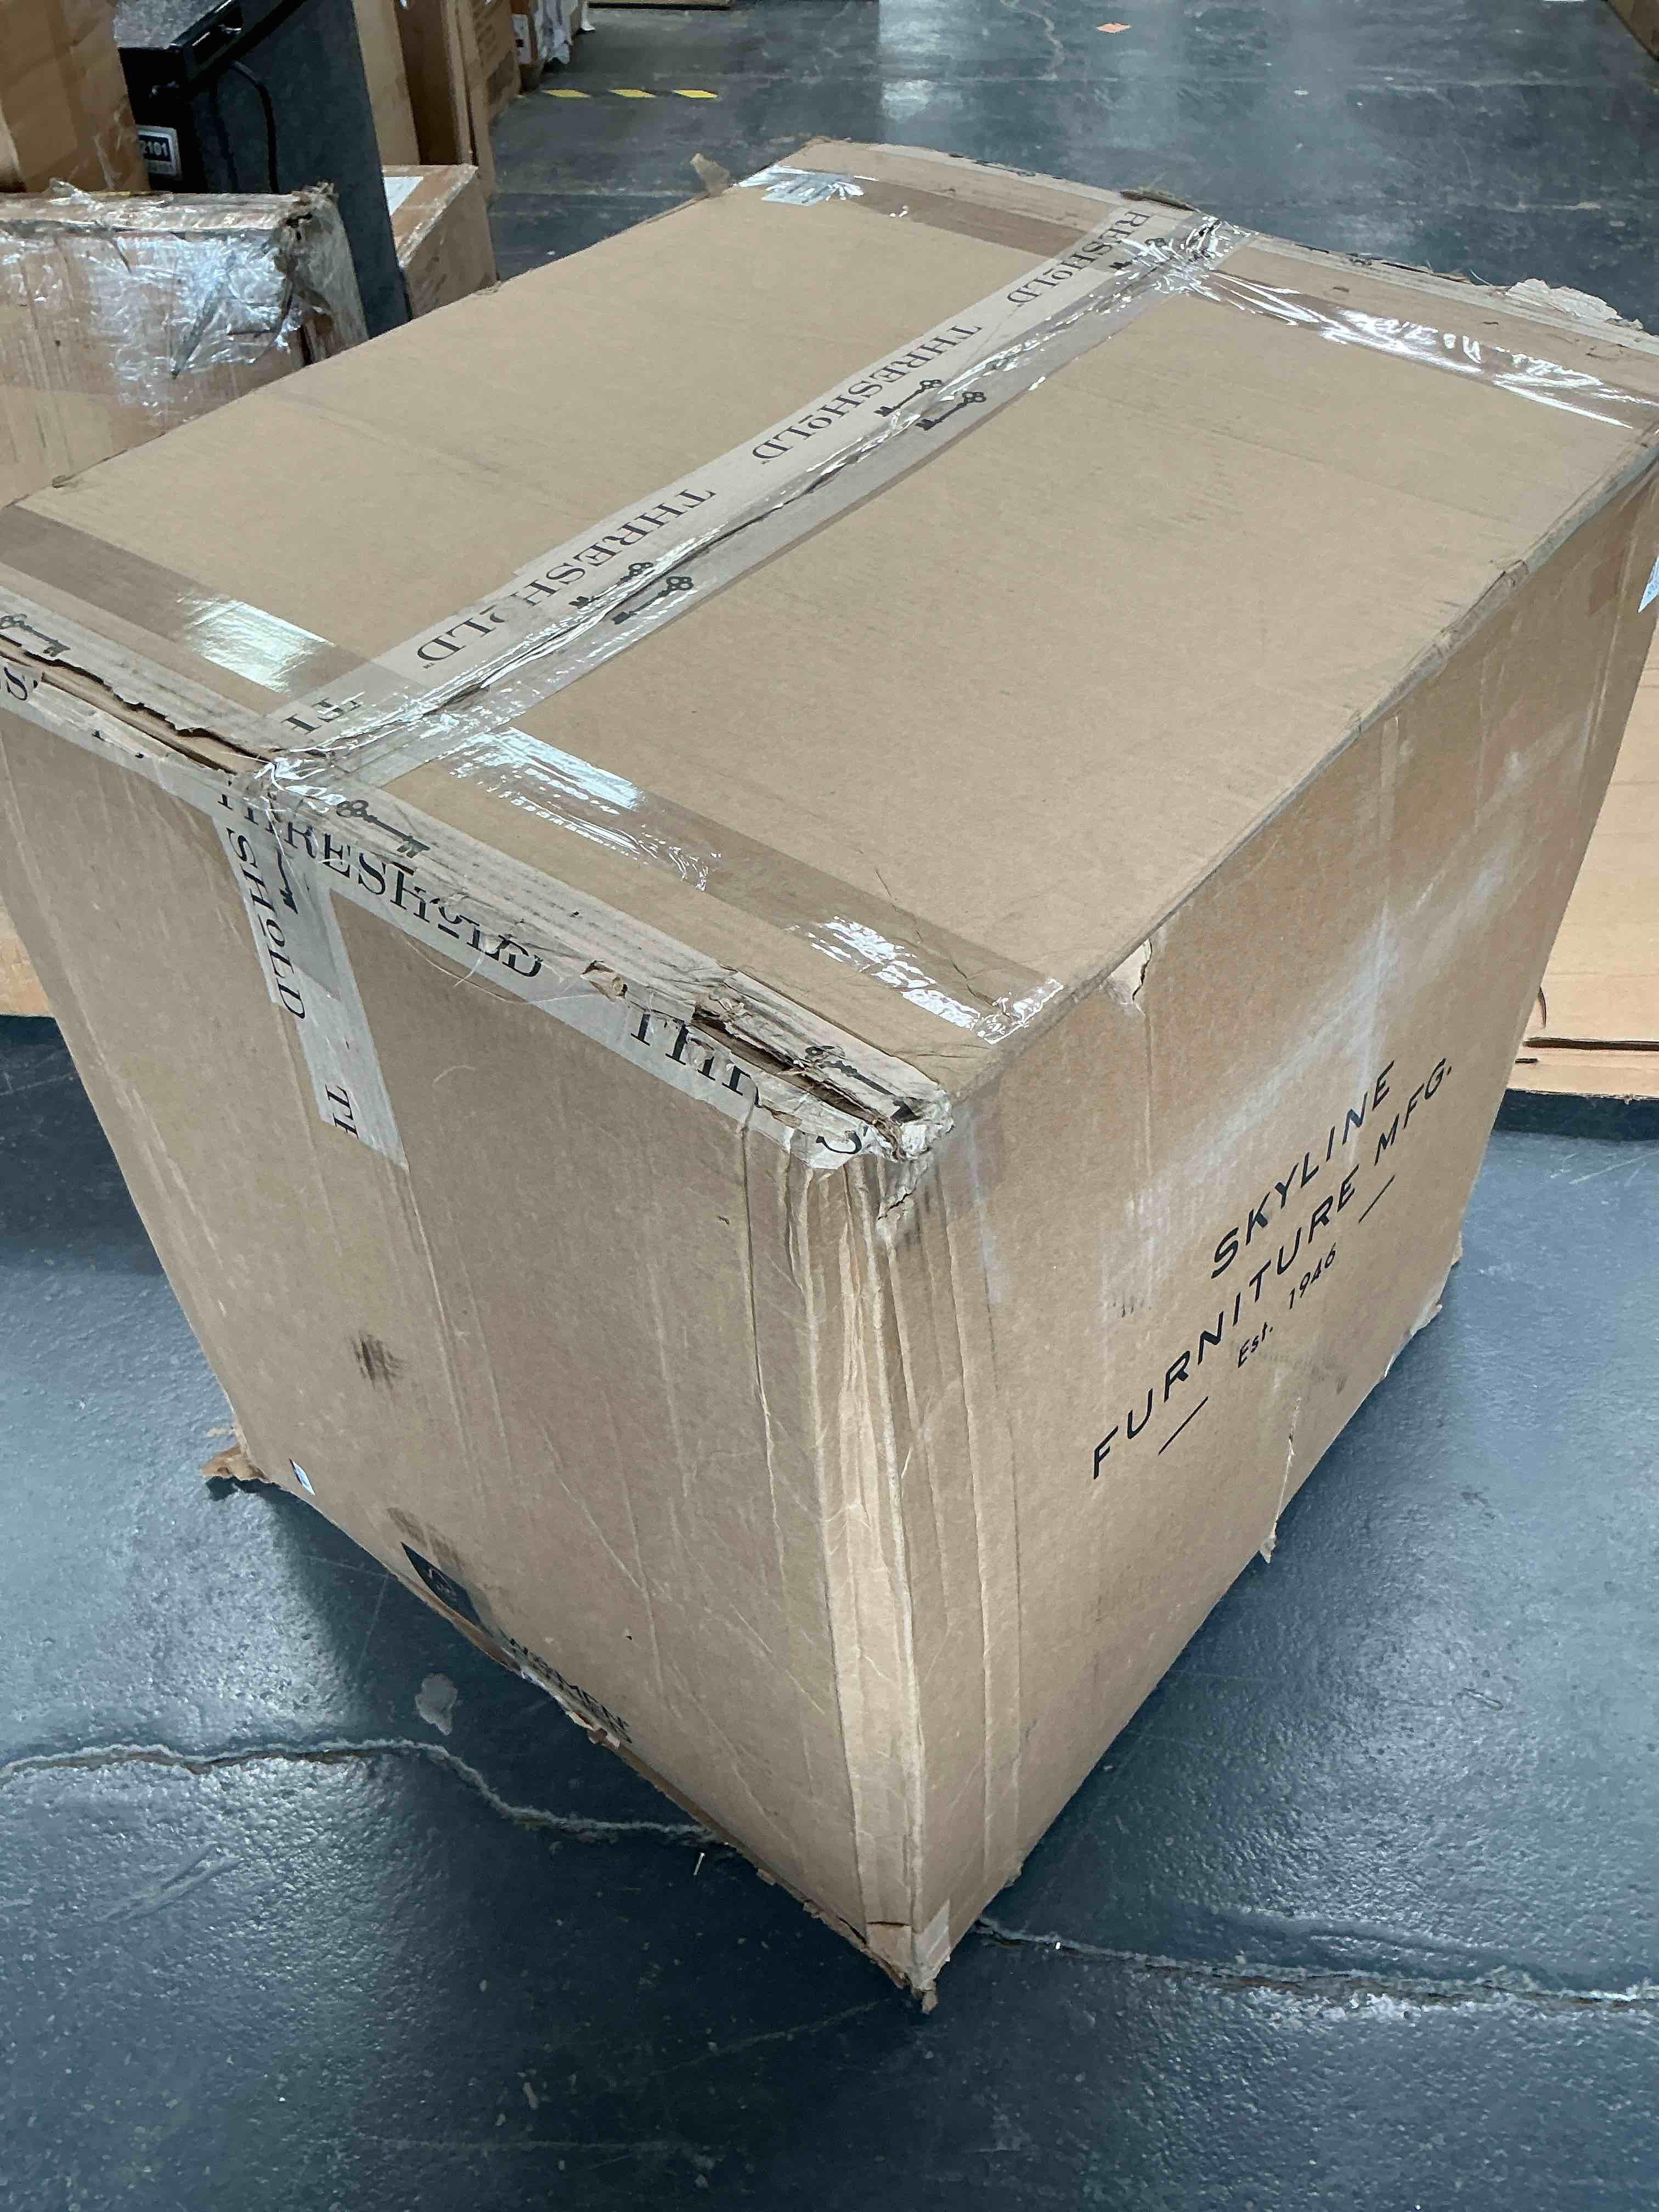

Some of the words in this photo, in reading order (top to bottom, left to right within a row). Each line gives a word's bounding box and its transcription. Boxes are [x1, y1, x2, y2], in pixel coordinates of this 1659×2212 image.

[1093, 1164, 1360, 1480] FURNITURE
[1374, 1058, 1453, 1166] MFG.
[1210, 1060, 1395, 1279] SKYLINE
[1238, 1321, 1274, 1369] Est.
[1289, 1242, 1338, 1310] 1946
